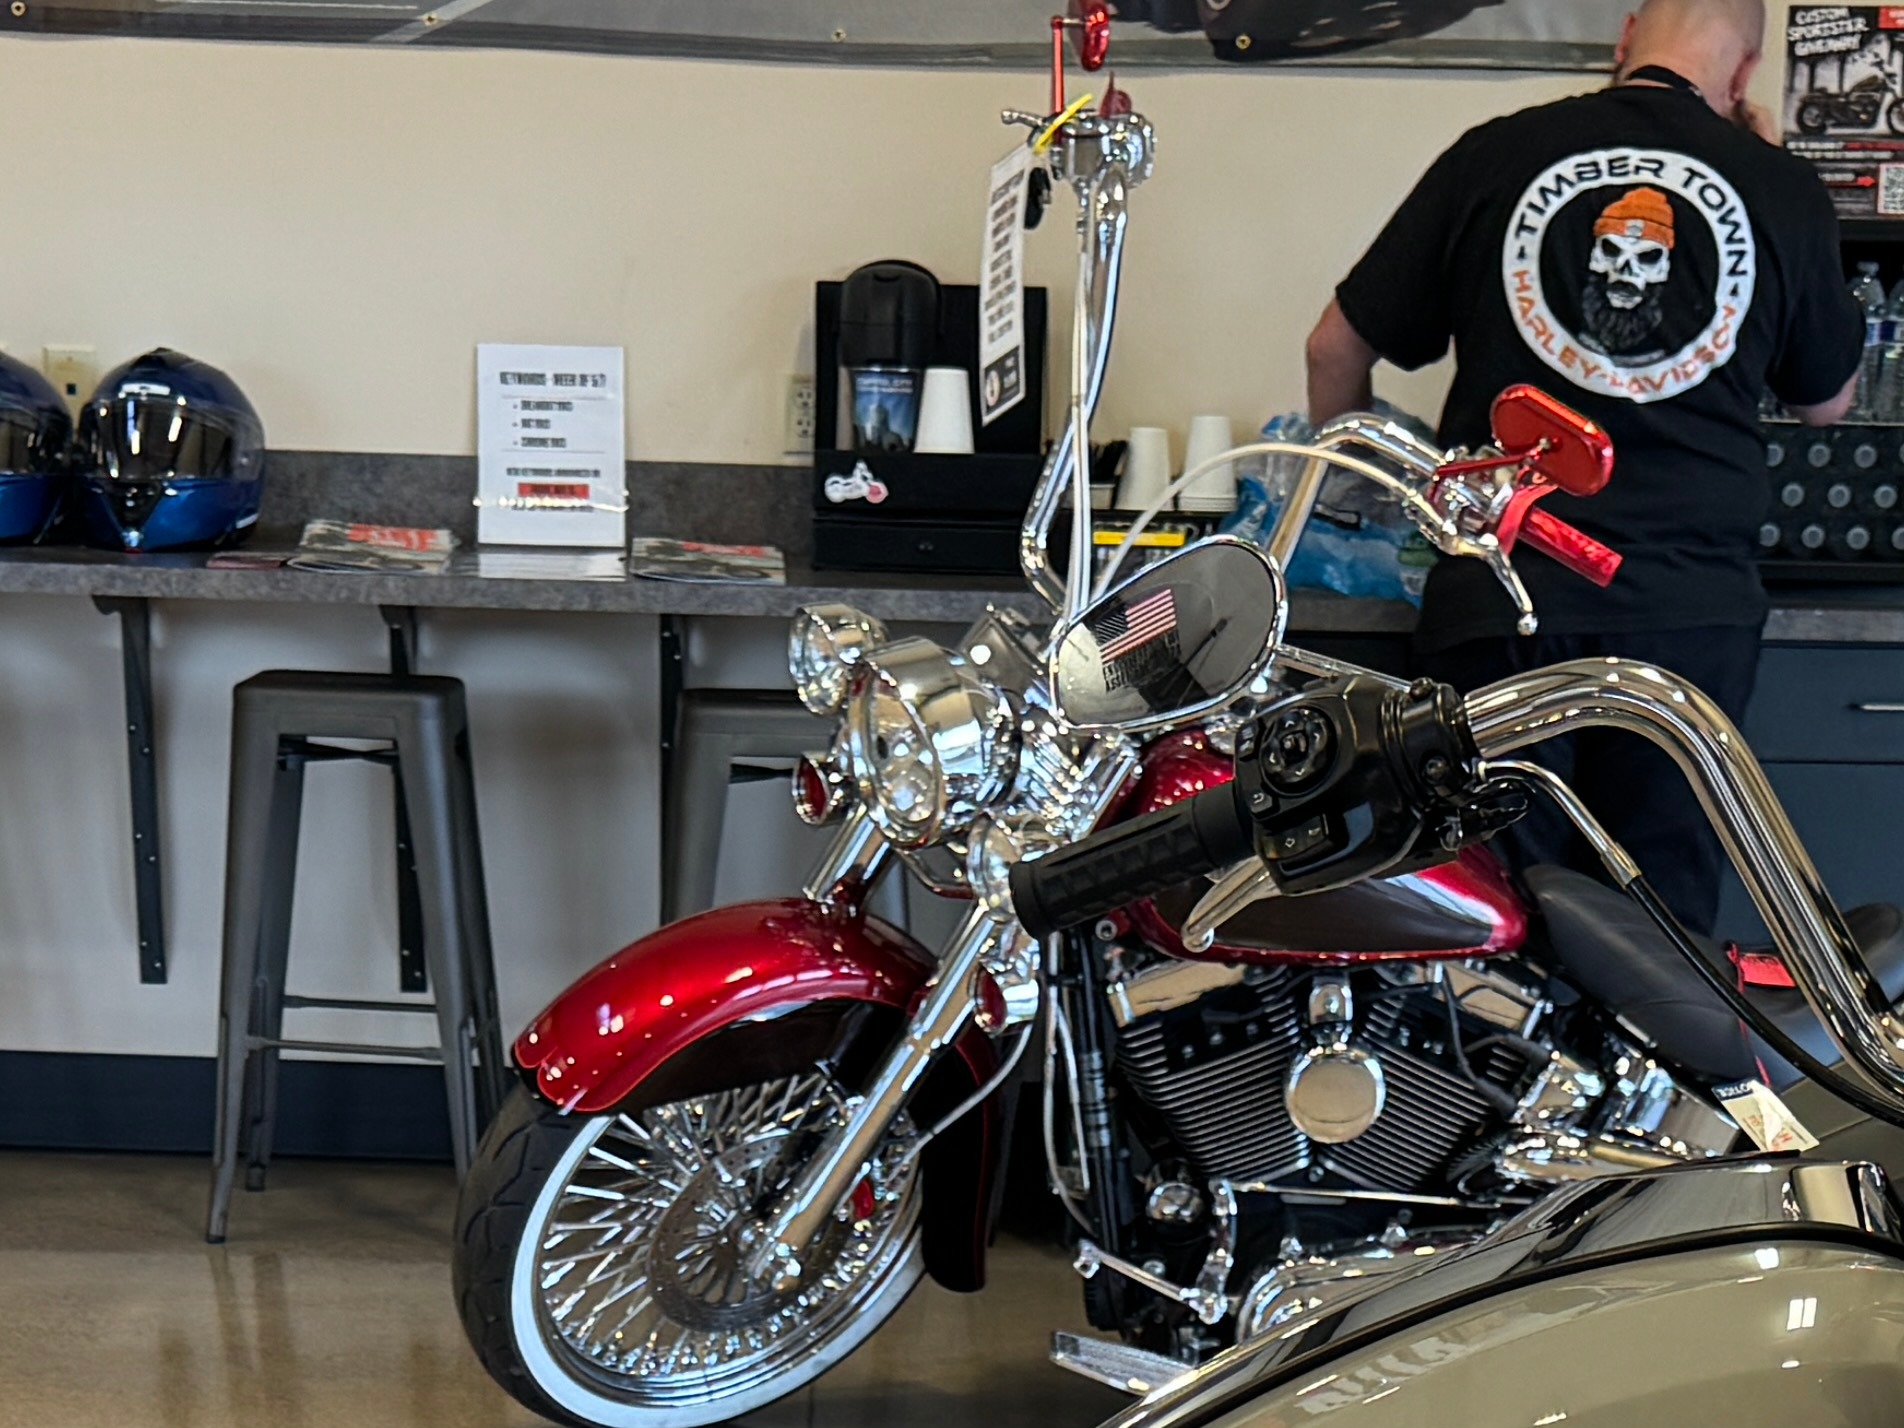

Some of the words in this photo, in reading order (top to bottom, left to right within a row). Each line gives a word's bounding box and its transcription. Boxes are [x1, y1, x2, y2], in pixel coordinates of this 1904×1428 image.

[1514, 155, 1667, 240] TIMBER
[1681, 166, 1749, 278] TOWN
[1716, 1082, 1750, 1097] OTICE
